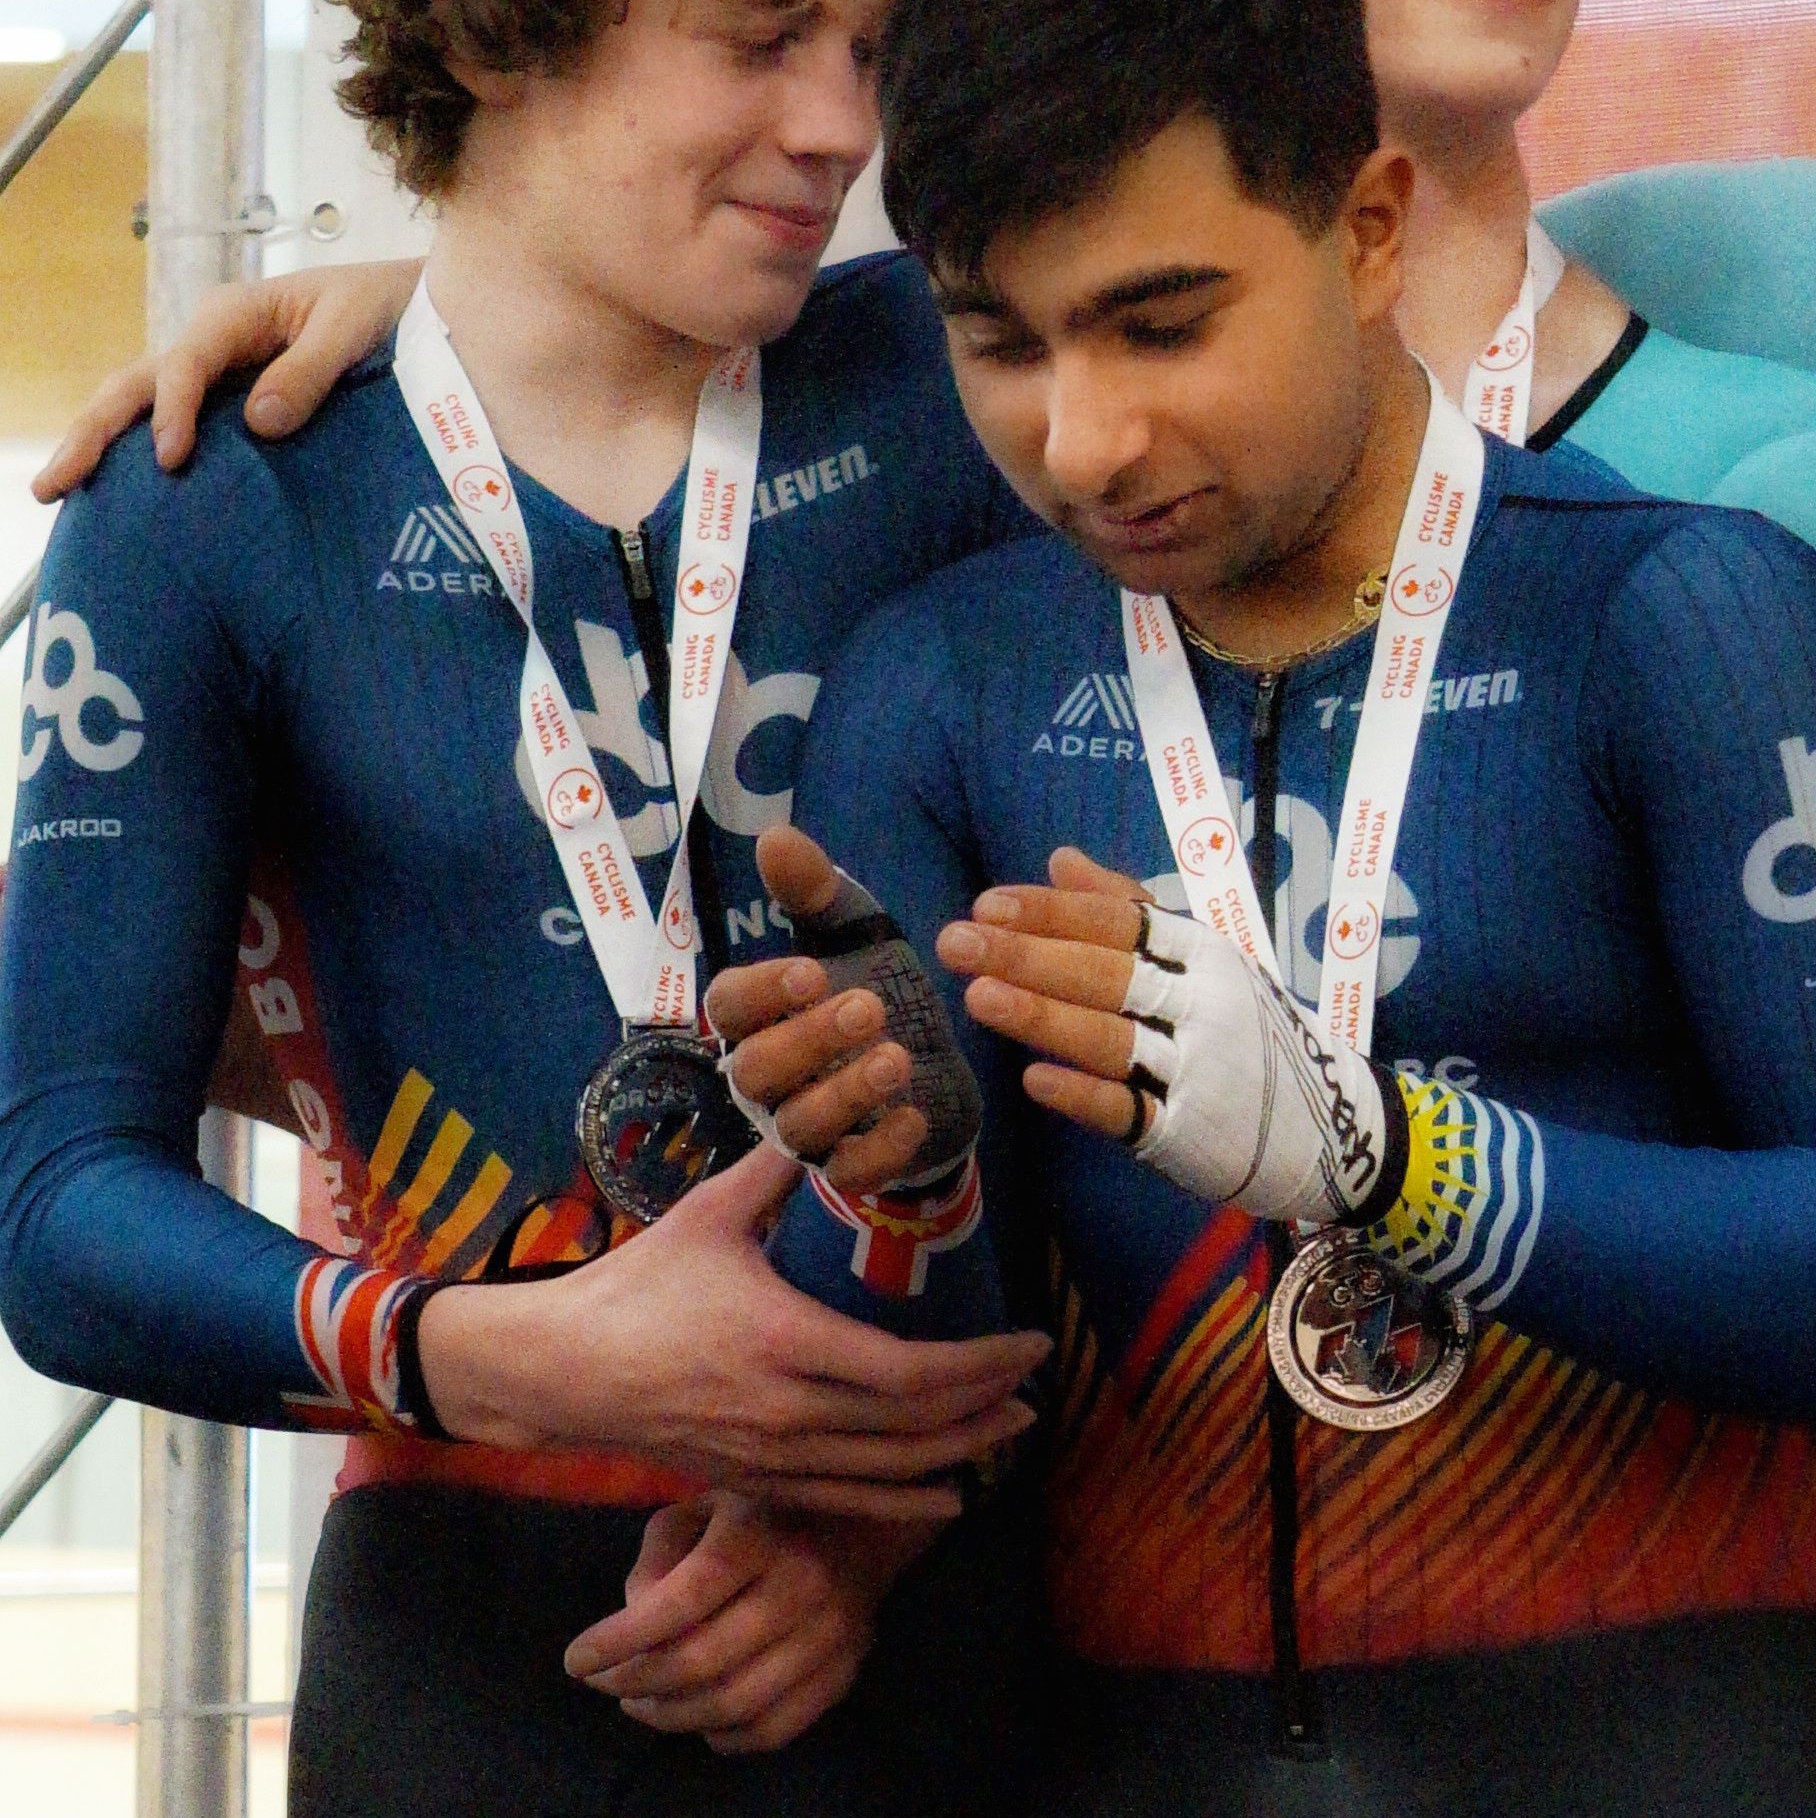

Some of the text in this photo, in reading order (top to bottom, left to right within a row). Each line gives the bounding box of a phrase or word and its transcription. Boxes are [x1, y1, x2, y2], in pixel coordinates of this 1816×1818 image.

[427, 403, 458, 454] CANADA
[446, 394, 478, 449] CYCLING
[698, 467, 719, 541] CYCLISME
[717, 482, 737, 541] CANADA
[1419, 471, 1448, 542] CYCLISME
[1438, 491, 1464, 547] CANADA
[376, 571, 507, 597] ADER
[683, 633, 699, 699] CYCLING
[698, 634, 716, 696] CANADA
[1381, 635, 1407, 699] CYCLING
[1400, 637, 1425, 698] CANADA
[530, 691, 554, 757] CANADA
[541, 683, 571, 750] CYCLING
[1032, 732, 1146, 761] ADER
[1163, 745, 1188, 807] CANADA
[1181, 736, 1208, 801] CYCLING
[18, 818, 121, 848] JAKROO
[1347, 798, 1371, 878] CYCLISME
[1365, 810, 1387, 876] CANADA
[579, 851, 611, 917] CANADA
[598, 843, 636, 922] CYCLISME
[1226, 888, 1259, 962] CYCLISM
